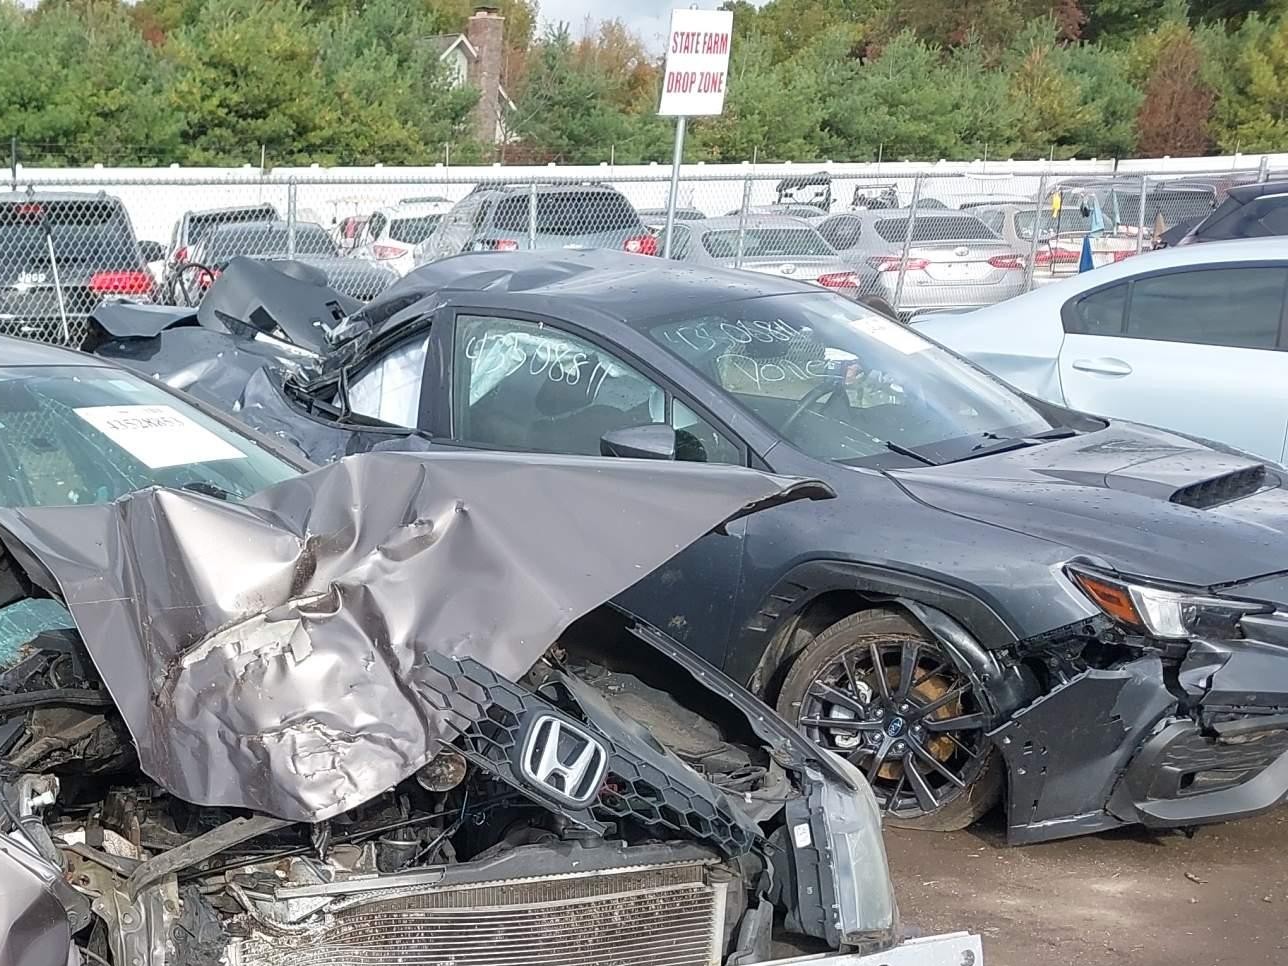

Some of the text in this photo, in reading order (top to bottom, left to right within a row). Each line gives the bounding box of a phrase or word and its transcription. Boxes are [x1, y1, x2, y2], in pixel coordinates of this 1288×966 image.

[672, 31, 729, 55] STATE FARM
[666, 72, 724, 93] DROP ZONE
